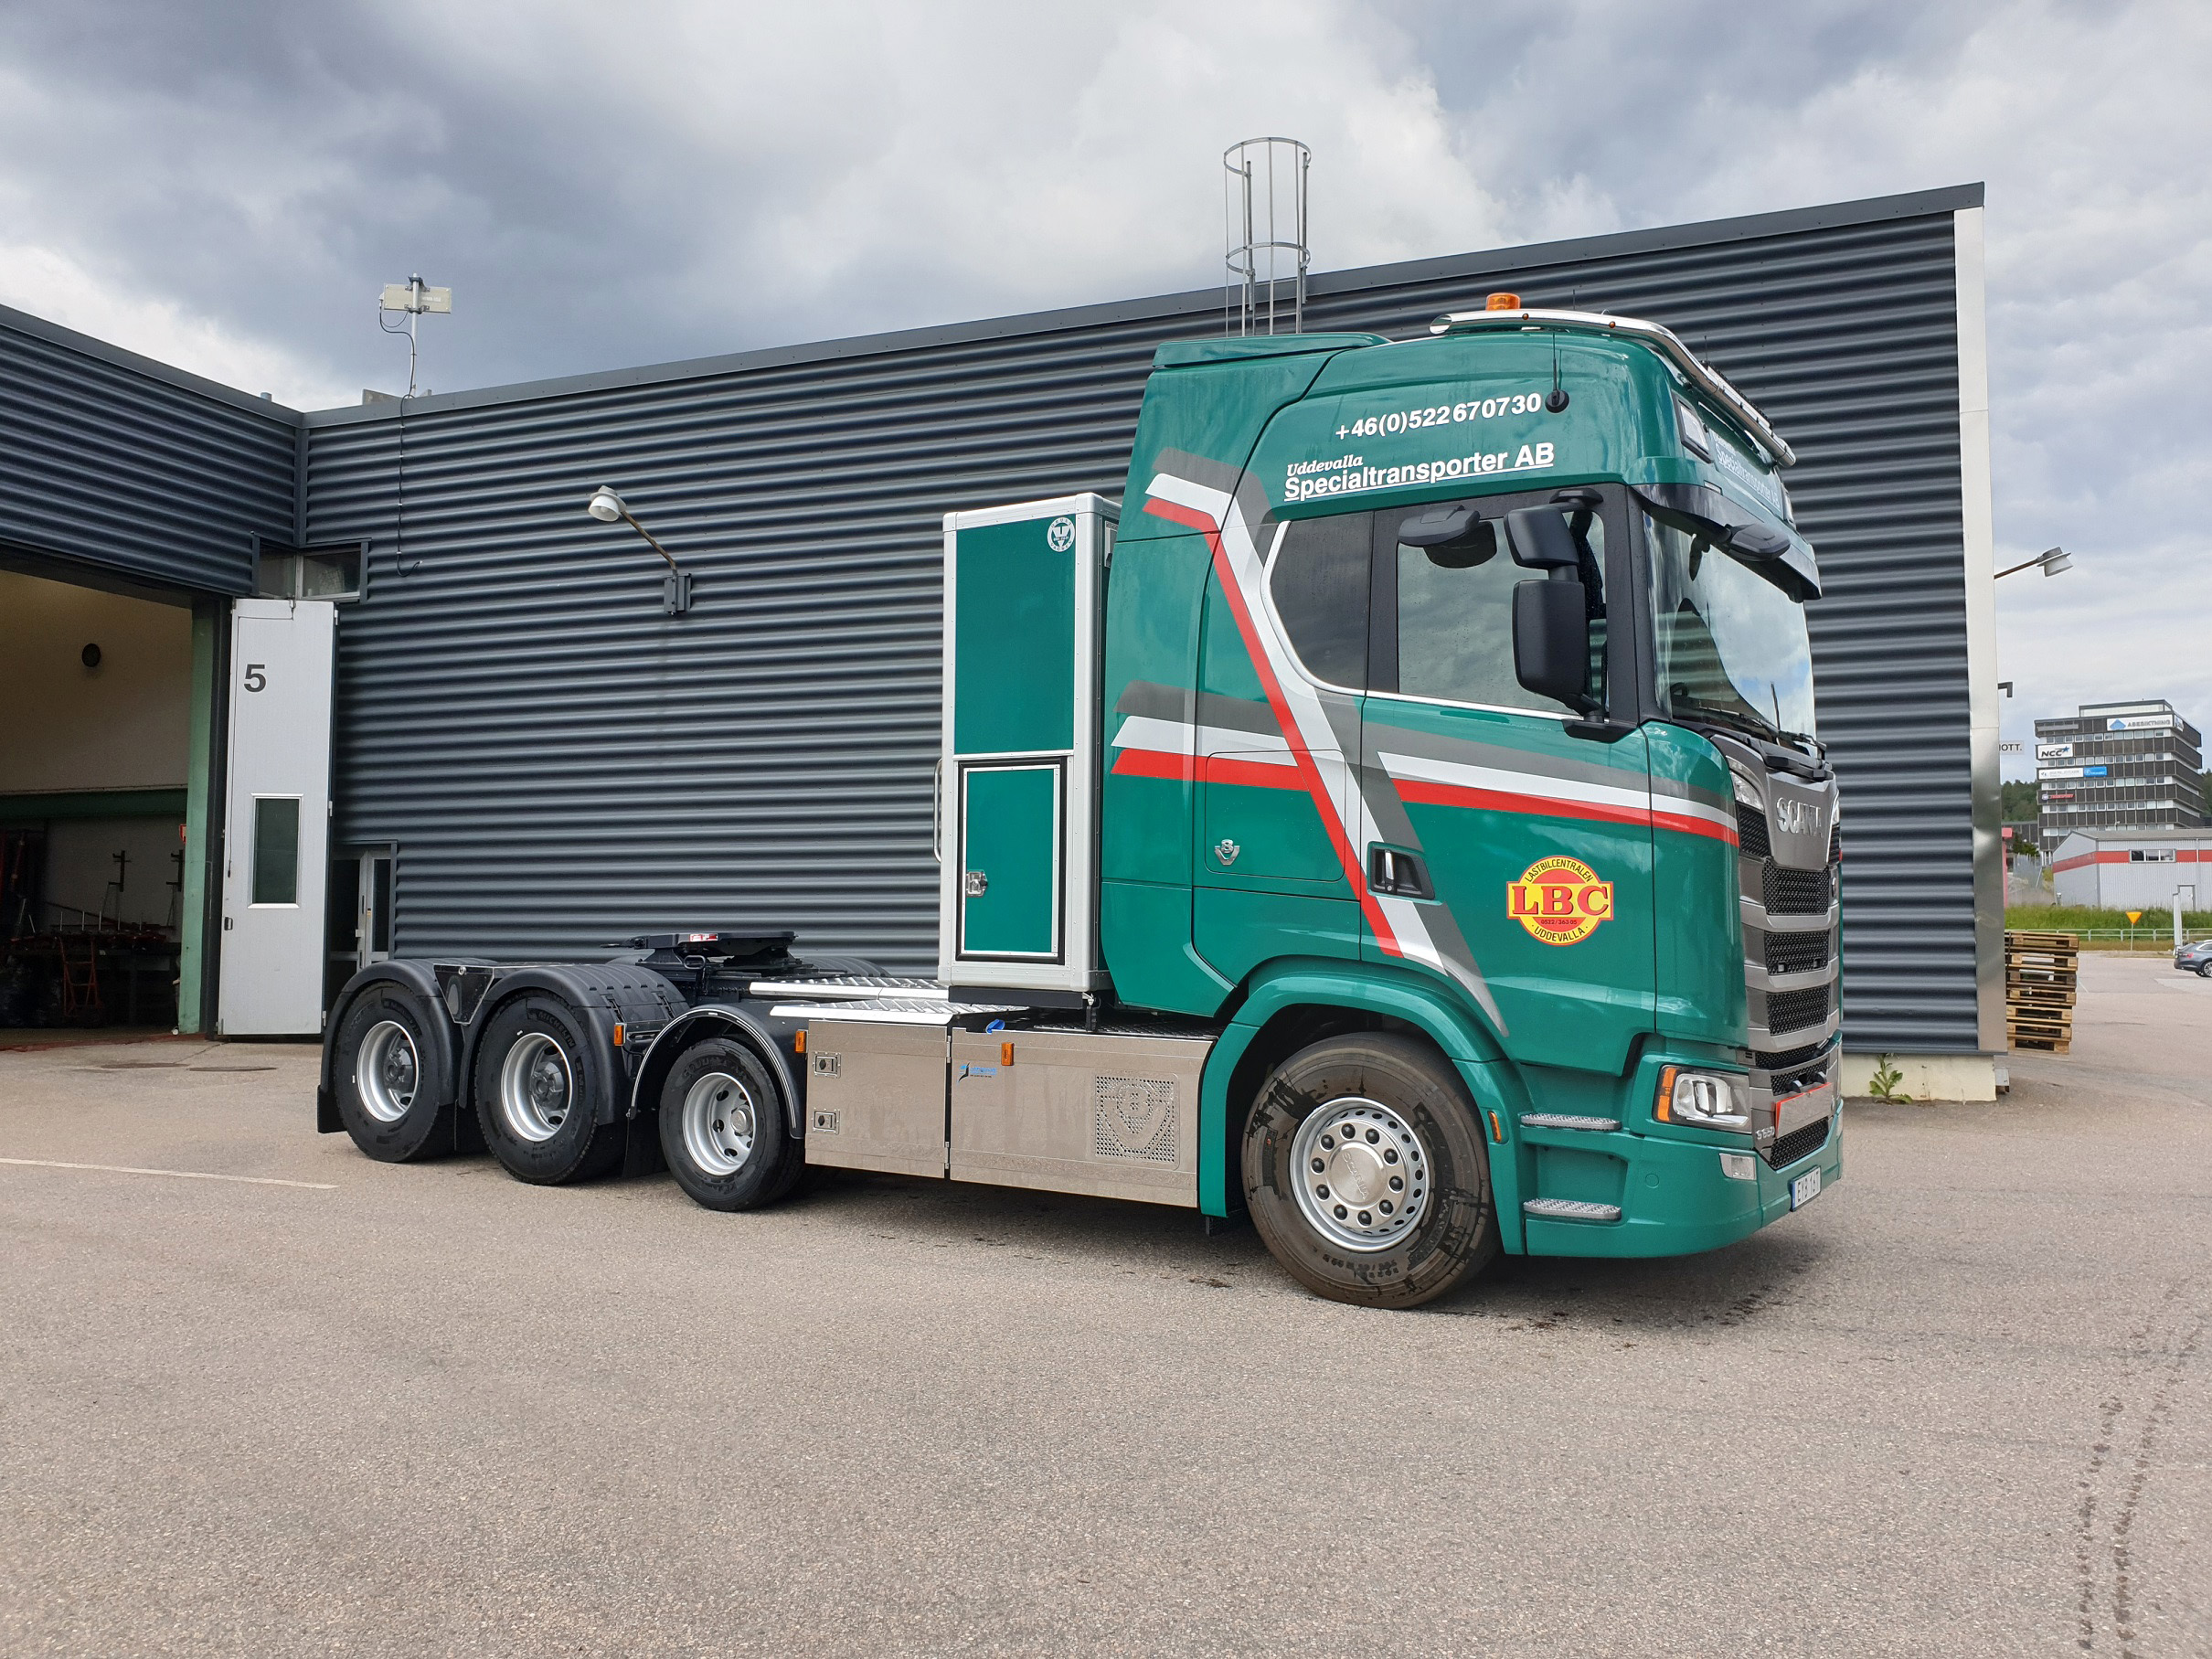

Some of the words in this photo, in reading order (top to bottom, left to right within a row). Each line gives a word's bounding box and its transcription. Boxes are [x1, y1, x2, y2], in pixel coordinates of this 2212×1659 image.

[1284, 452, 1508, 501] Specialtransporter
[1515, 442, 1554, 468] AB
[1287, 454, 1363, 477] Uddevalla
[243, 664, 267, 693] 5
[2041, 750, 2062, 758] NCC
[1525, 858, 1593, 883] LASTBILCENTRALEN
[1512, 885, 1609, 916] LBC
[1534, 927, 1586, 942] UDDEVALLA
[1342, 1152, 1369, 1200] SCANIA
